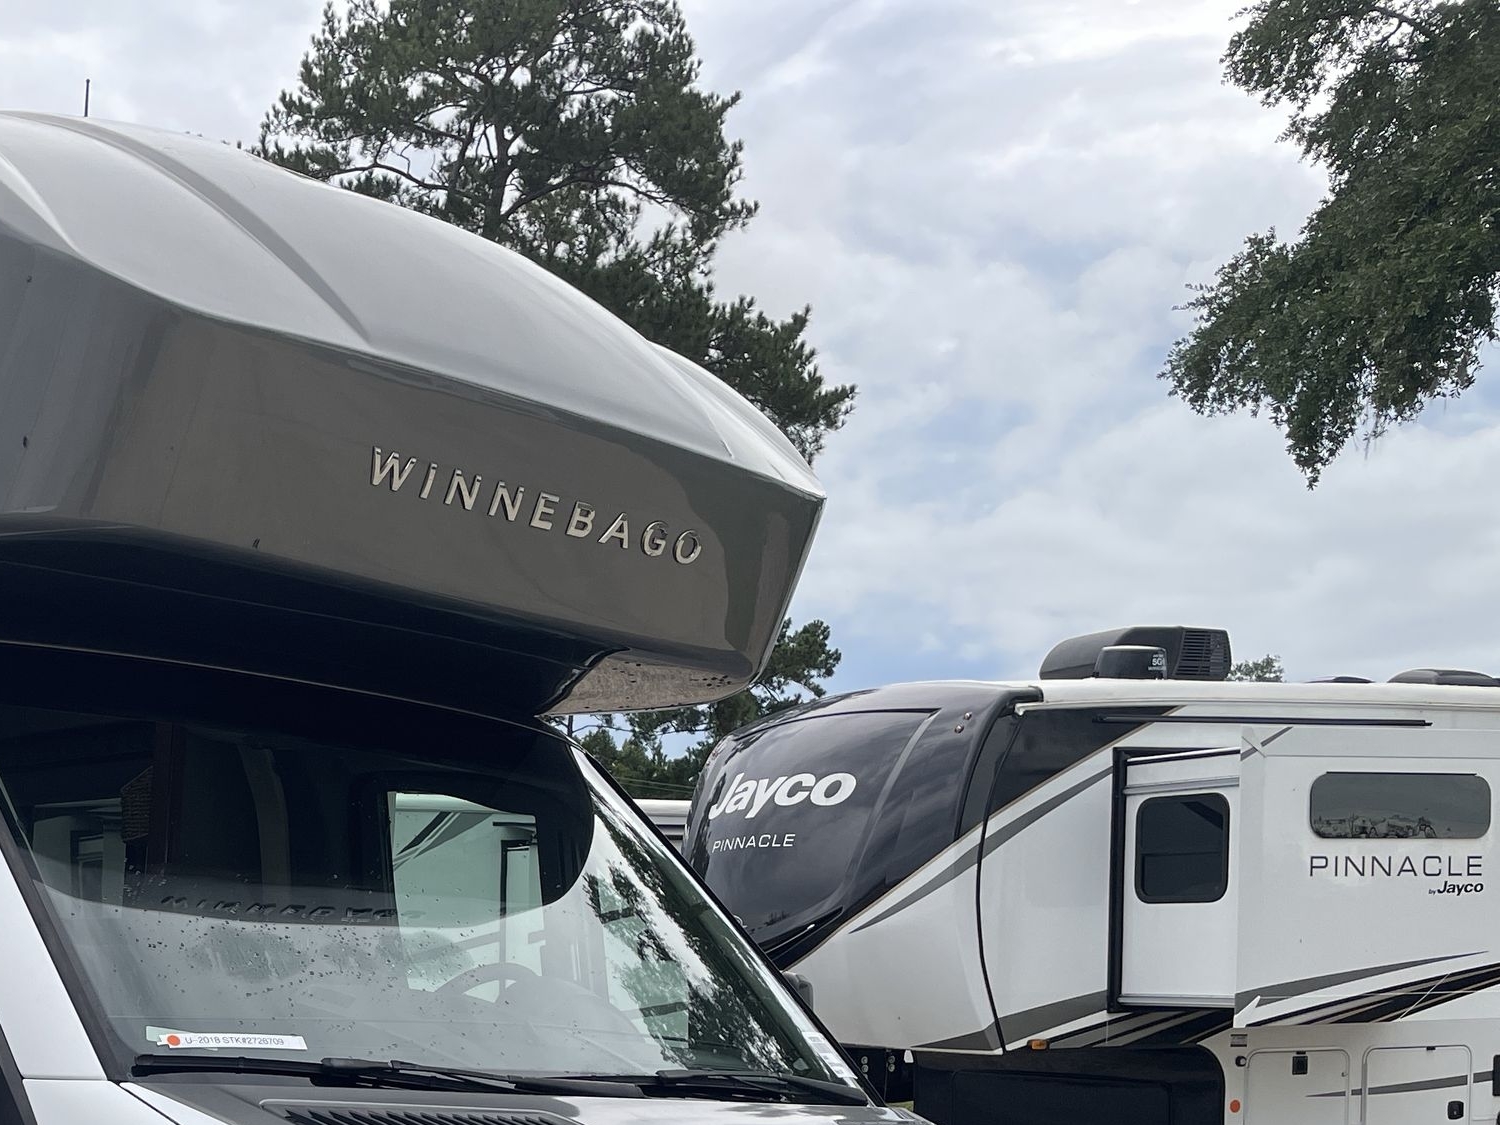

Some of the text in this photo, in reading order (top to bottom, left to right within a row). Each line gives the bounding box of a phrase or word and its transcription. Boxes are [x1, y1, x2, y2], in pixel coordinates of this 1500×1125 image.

[371, 446, 703, 565] WINNEBAGO
[708, 772, 857, 820] Jayco
[712, 833, 796, 854] PINNACLE
[1309, 855, 1483, 877] PINNACLE
[1437, 880, 1484, 896] Jayco
